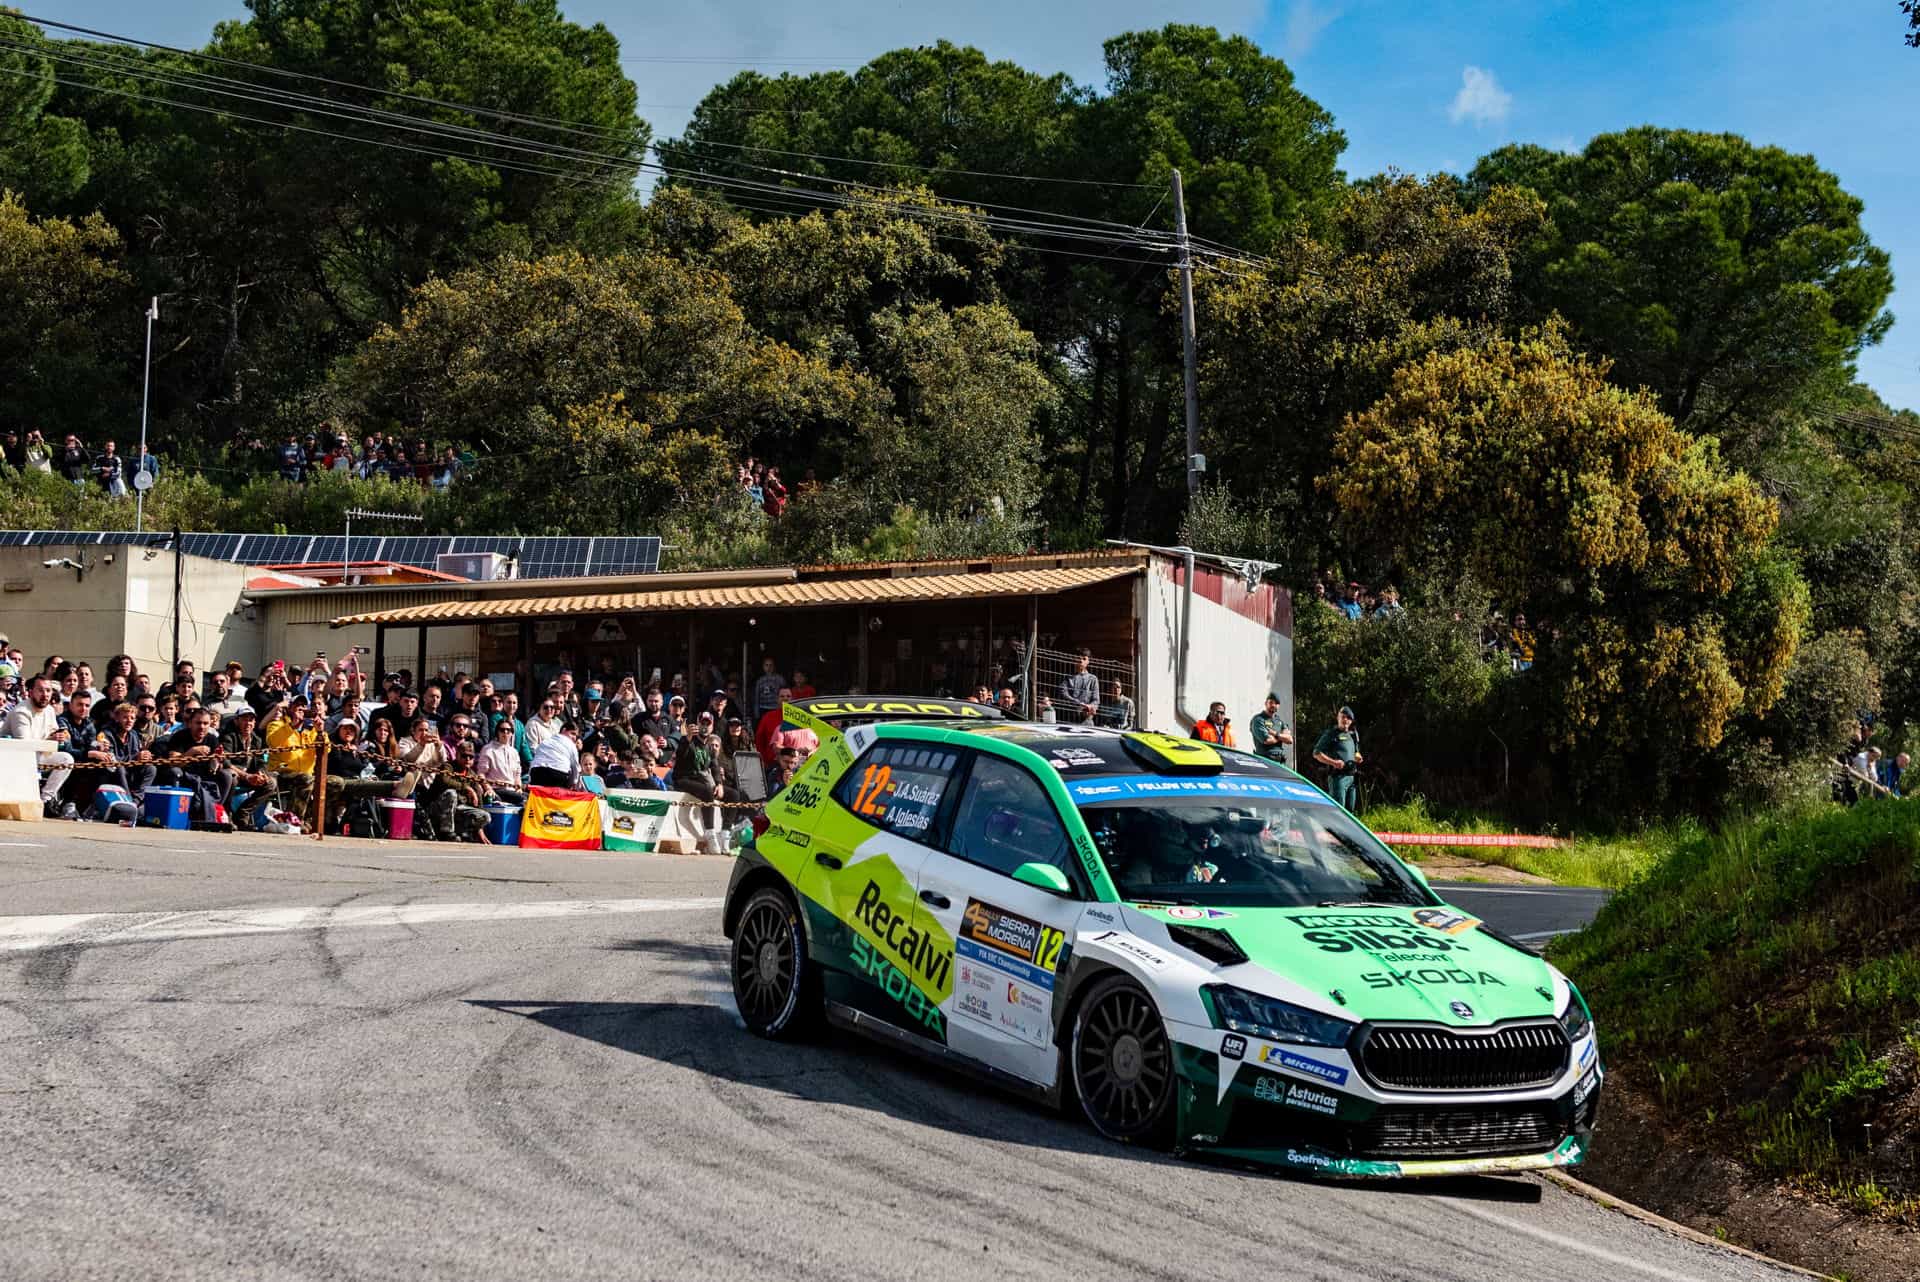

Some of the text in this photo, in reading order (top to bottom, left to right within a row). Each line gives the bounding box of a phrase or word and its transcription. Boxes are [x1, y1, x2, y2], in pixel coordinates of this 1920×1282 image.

[852, 763, 892, 815] 12
[855, 879, 953, 992] Recalvi
[987, 925, 1032, 952] MORENA
[999, 915, 1036, 939] SIERRA
[1036, 926, 1065, 973] 12
[850, 933, 946, 1041] SKODA
[1360, 968, 1508, 989] SKODA
[1225, 1037, 1245, 1051] UFI
[1284, 1056, 1341, 1080] MICHELIN
[1287, 1083, 1339, 1107] Asturias
